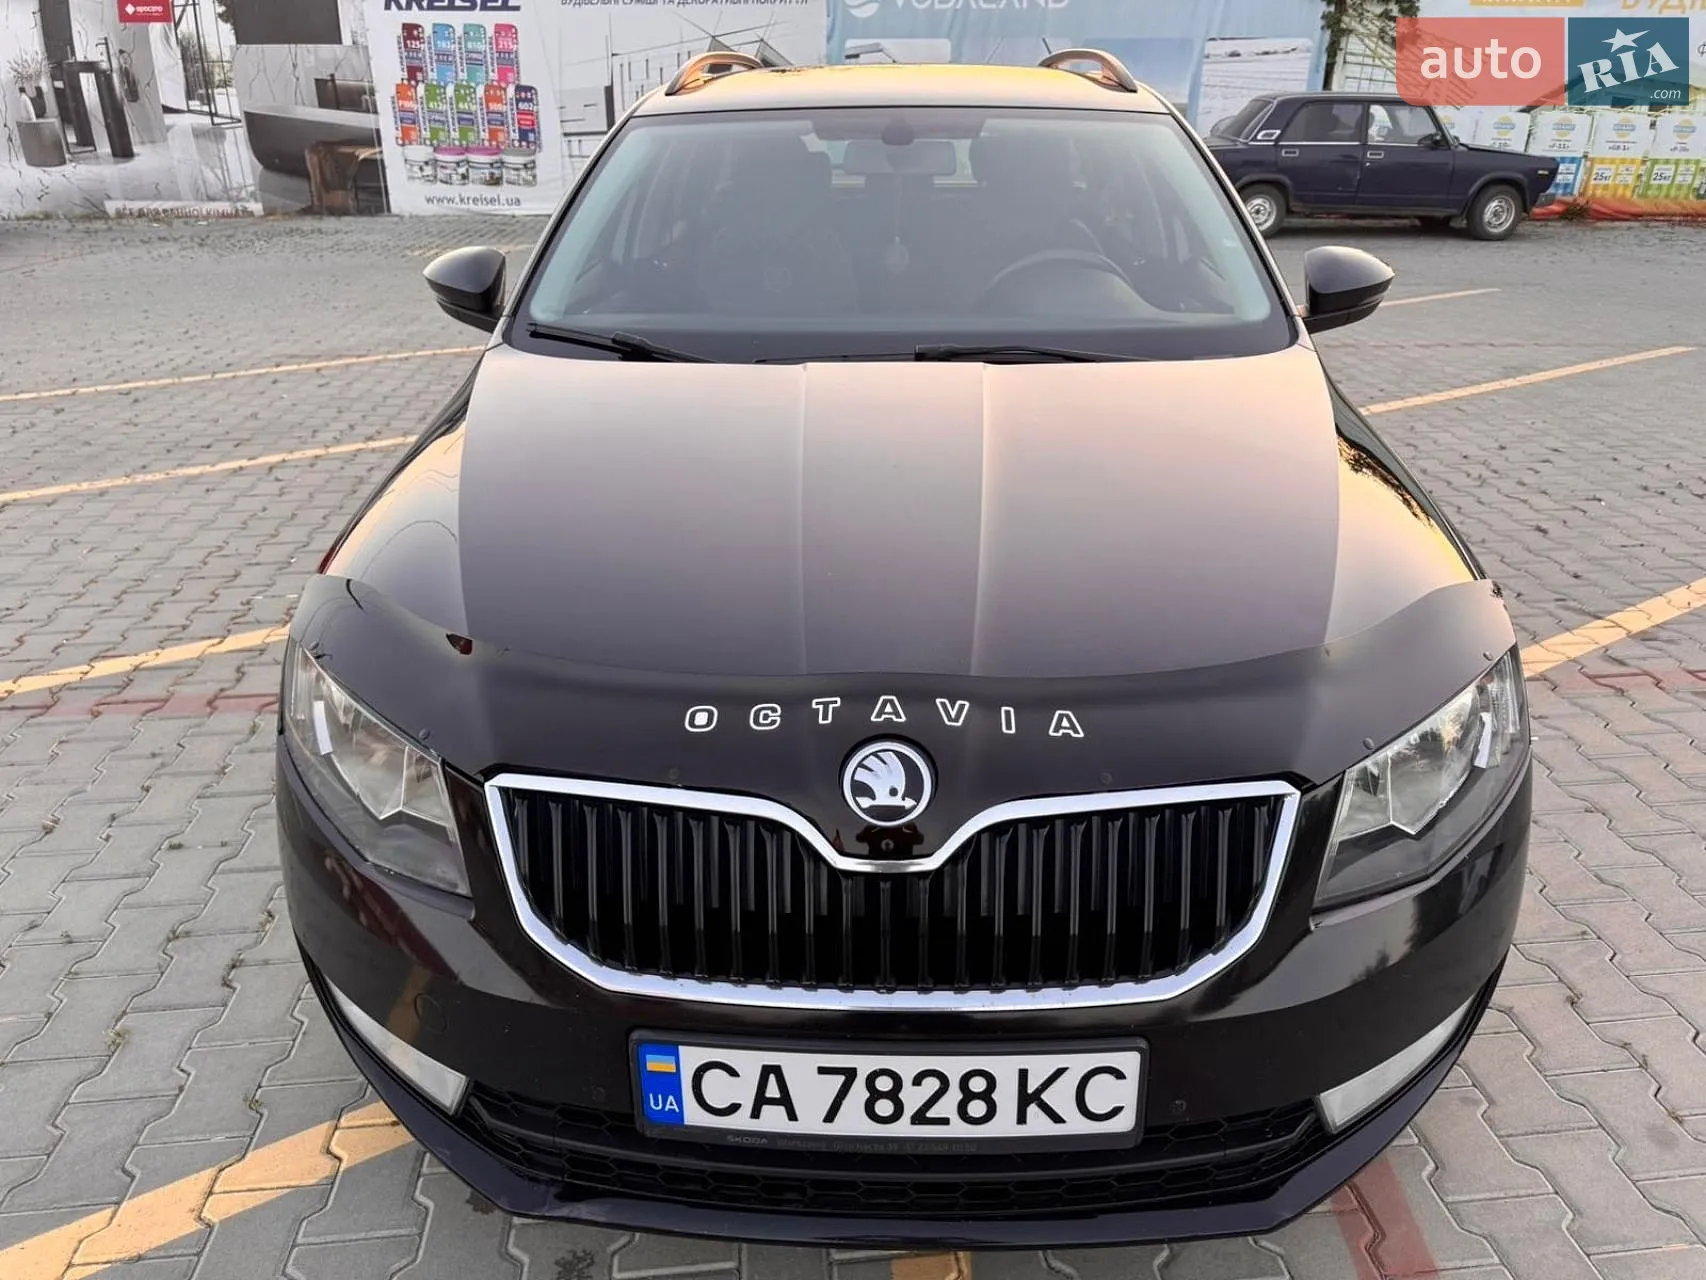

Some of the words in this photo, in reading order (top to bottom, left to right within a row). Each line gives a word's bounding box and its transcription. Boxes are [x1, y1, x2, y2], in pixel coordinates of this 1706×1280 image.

[425, 194, 521, 206] www.kreisel.ua
[685, 695, 1085, 738] OCTAVIA
[649, 1093, 680, 1113] UA
[691, 1060, 800, 1122] CA
[816, 1066, 998, 1126] 7828
[1015, 1065, 1128, 1125] KC
